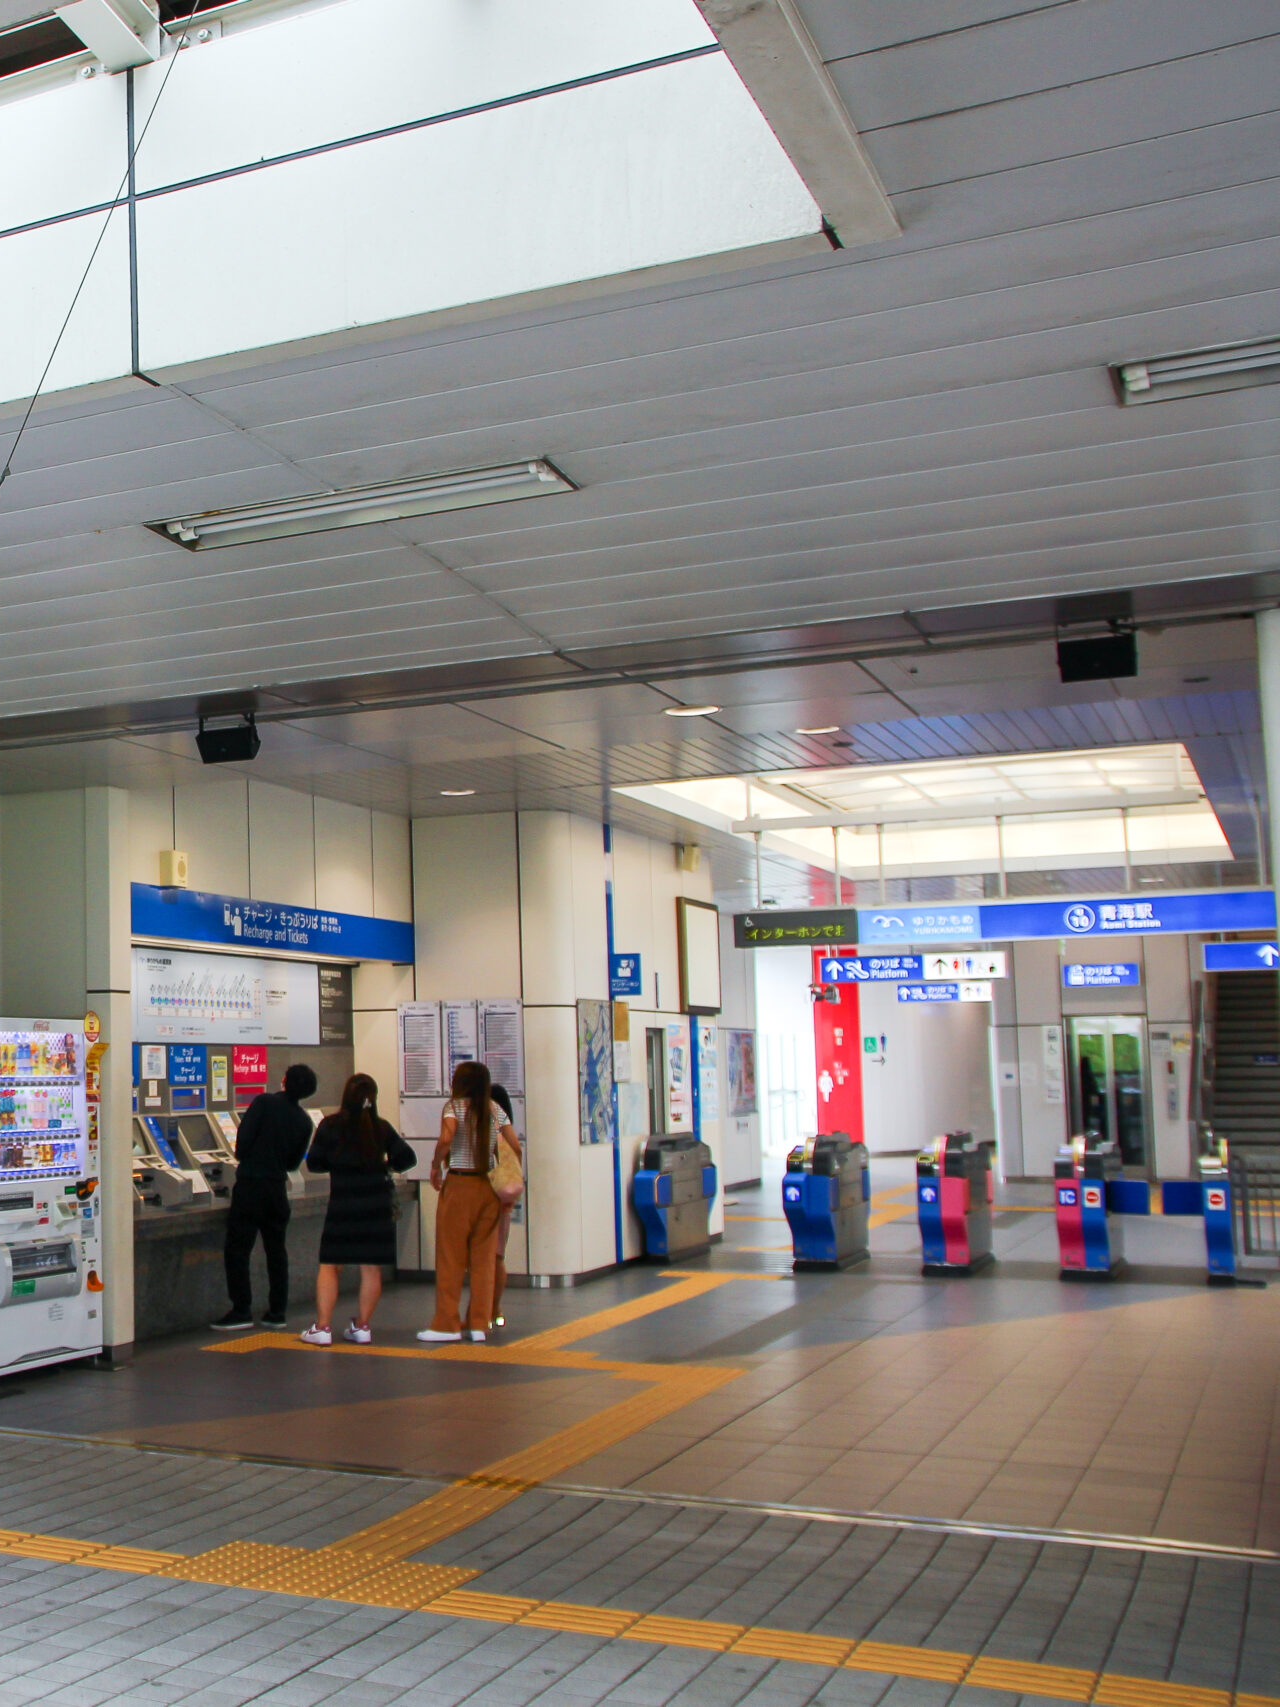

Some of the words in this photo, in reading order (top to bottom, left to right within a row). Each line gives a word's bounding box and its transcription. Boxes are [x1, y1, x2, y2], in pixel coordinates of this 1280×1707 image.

[1099, 903, 1153, 920] 青海駅
[913, 915, 974, 926] ゆりかもめ
[1070, 915, 1090, 928] 10
[1101, 920, 1126, 930] Aomi
[1126, 919, 1161, 929] Station
[243, 923, 273, 943] Recharge
[275, 928, 286, 942] and
[288, 929, 308, 944] Tickets
[869, 958, 901, 969] のりば
[871, 969, 909, 979] Platform
[1084, 966, 1113, 976] のりば
[1085, 976, 1121, 985] Platform
[241, 1053, 260, 1064] チャージ
[1059, 1189, 1076, 1205] IC
